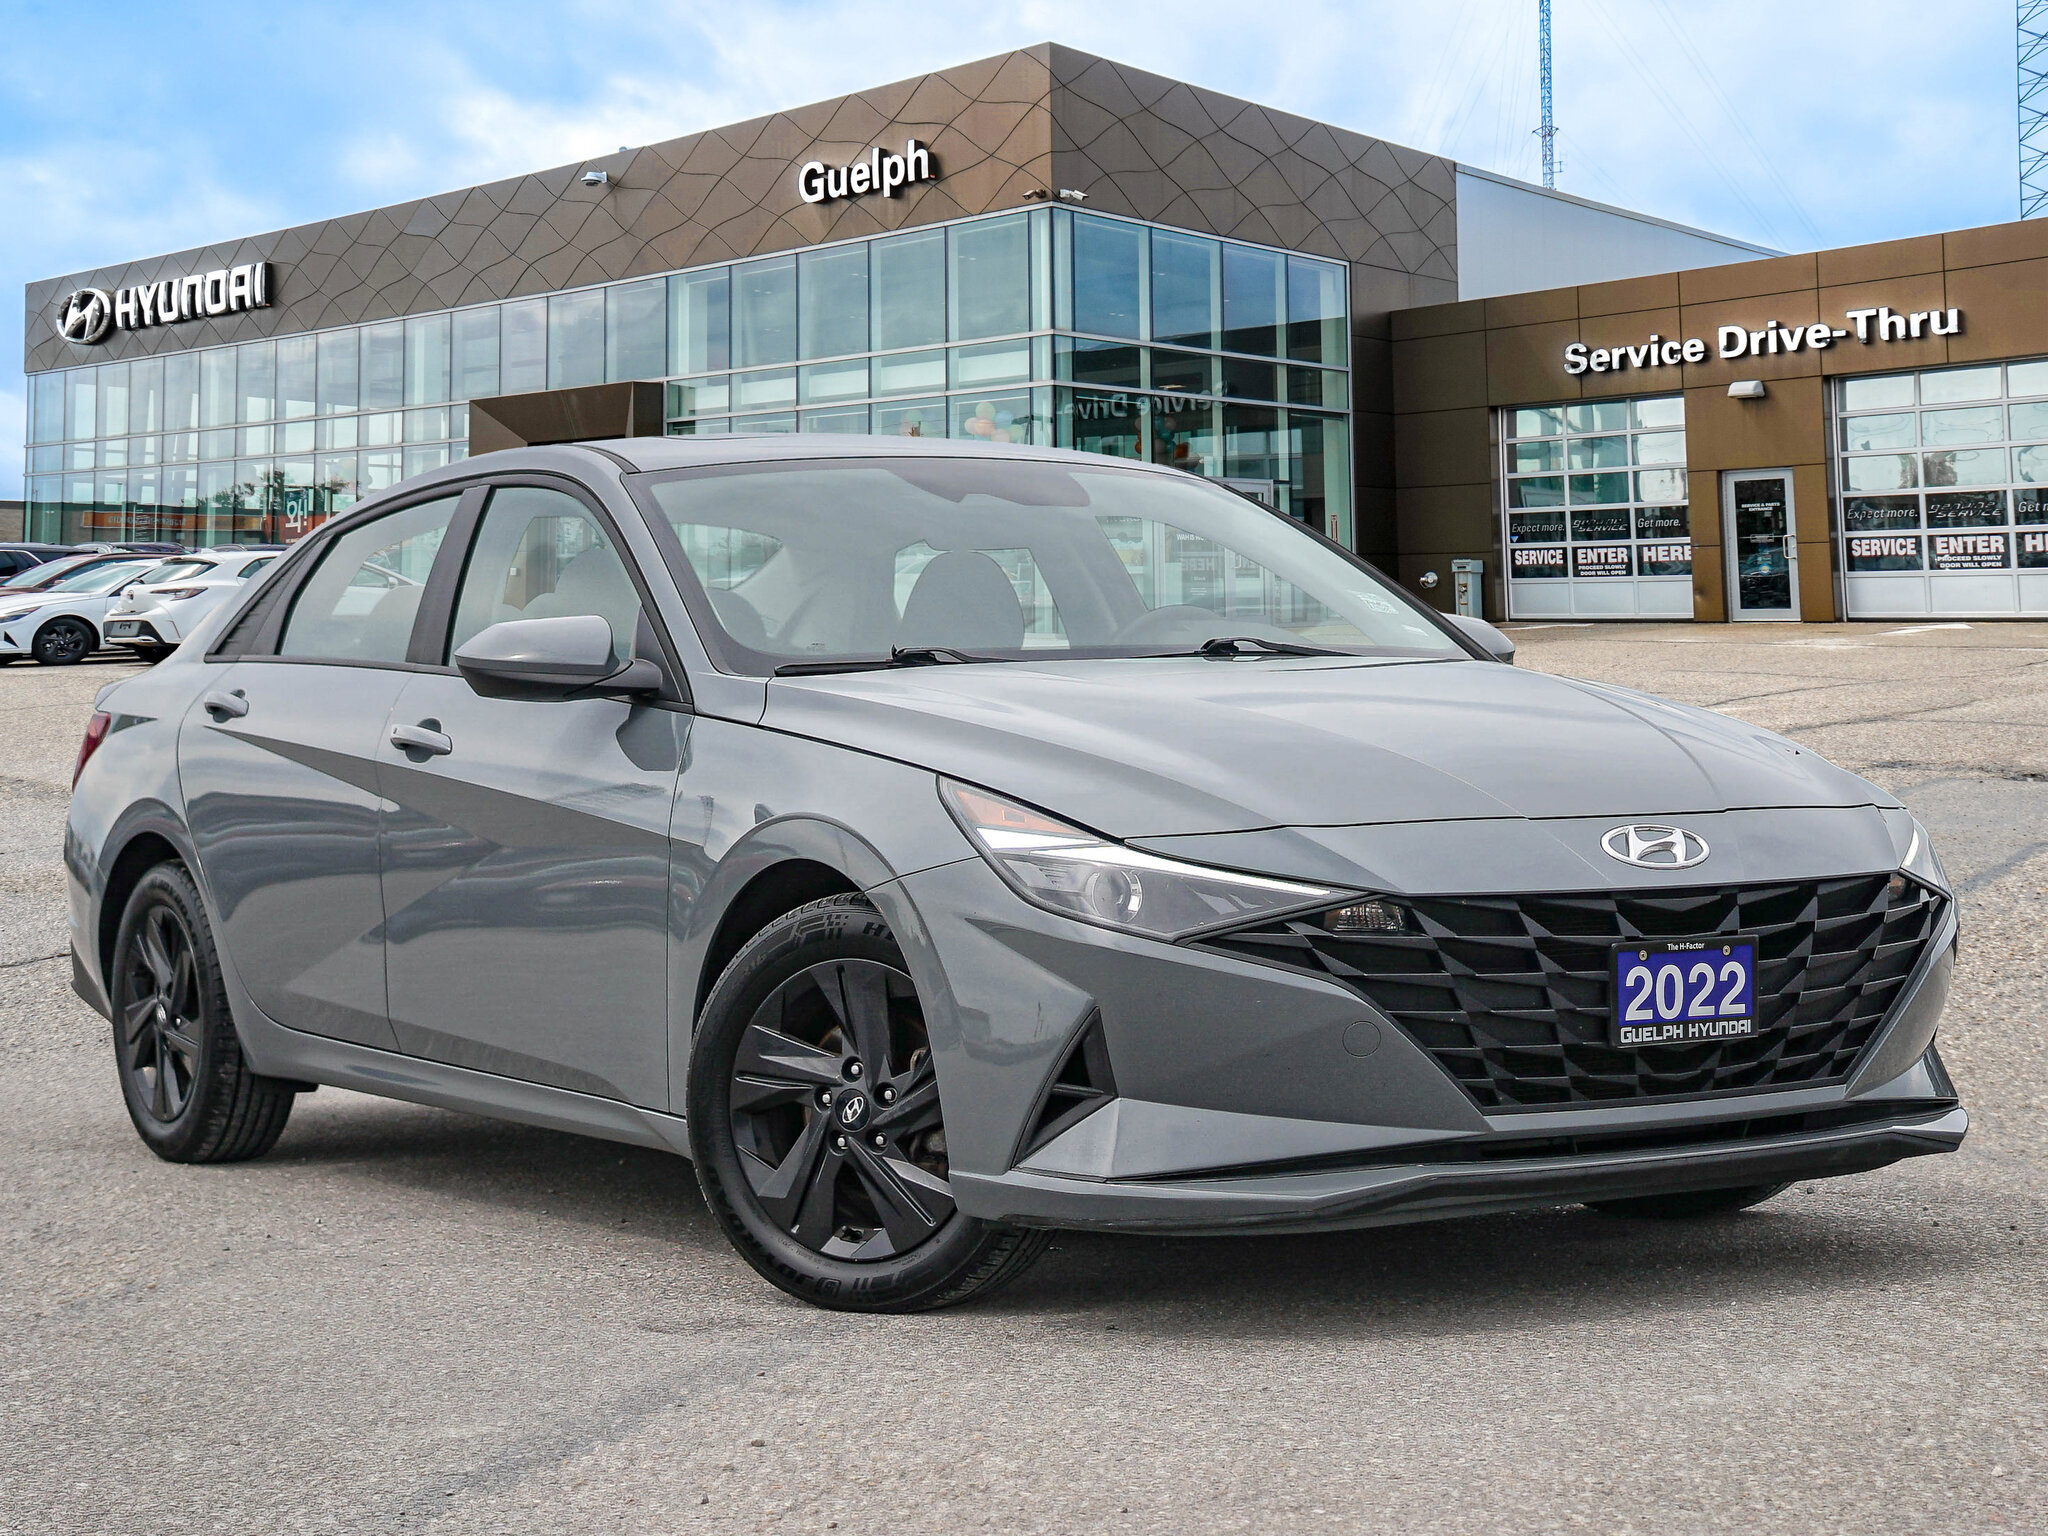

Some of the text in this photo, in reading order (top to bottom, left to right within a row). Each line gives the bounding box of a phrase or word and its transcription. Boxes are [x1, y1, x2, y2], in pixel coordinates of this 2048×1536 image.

[798, 138, 930, 203] Guelph
[115, 262, 269, 330] HYUNDAI
[1563, 306, 1962, 375] Service Drive-Thru
[1847, 508, 1919, 521] Expect more.
[2018, 501, 2041, 513] Get
[1512, 523, 1565, 535] Expect more.
[1637, 518, 1681, 529] Get more.
[1851, 537, 1917, 557] SERVICE
[1935, 535, 2005, 555] ENTER
[1514, 549, 1564, 566] SERVICE
[1577, 547, 1629, 564] ENTER
[1667, 942, 1705, 951] The H-Factor
[1625, 961, 1746, 1021] 2022
[1620, 1019, 1752, 1044] GUELPH HYUNDAI
